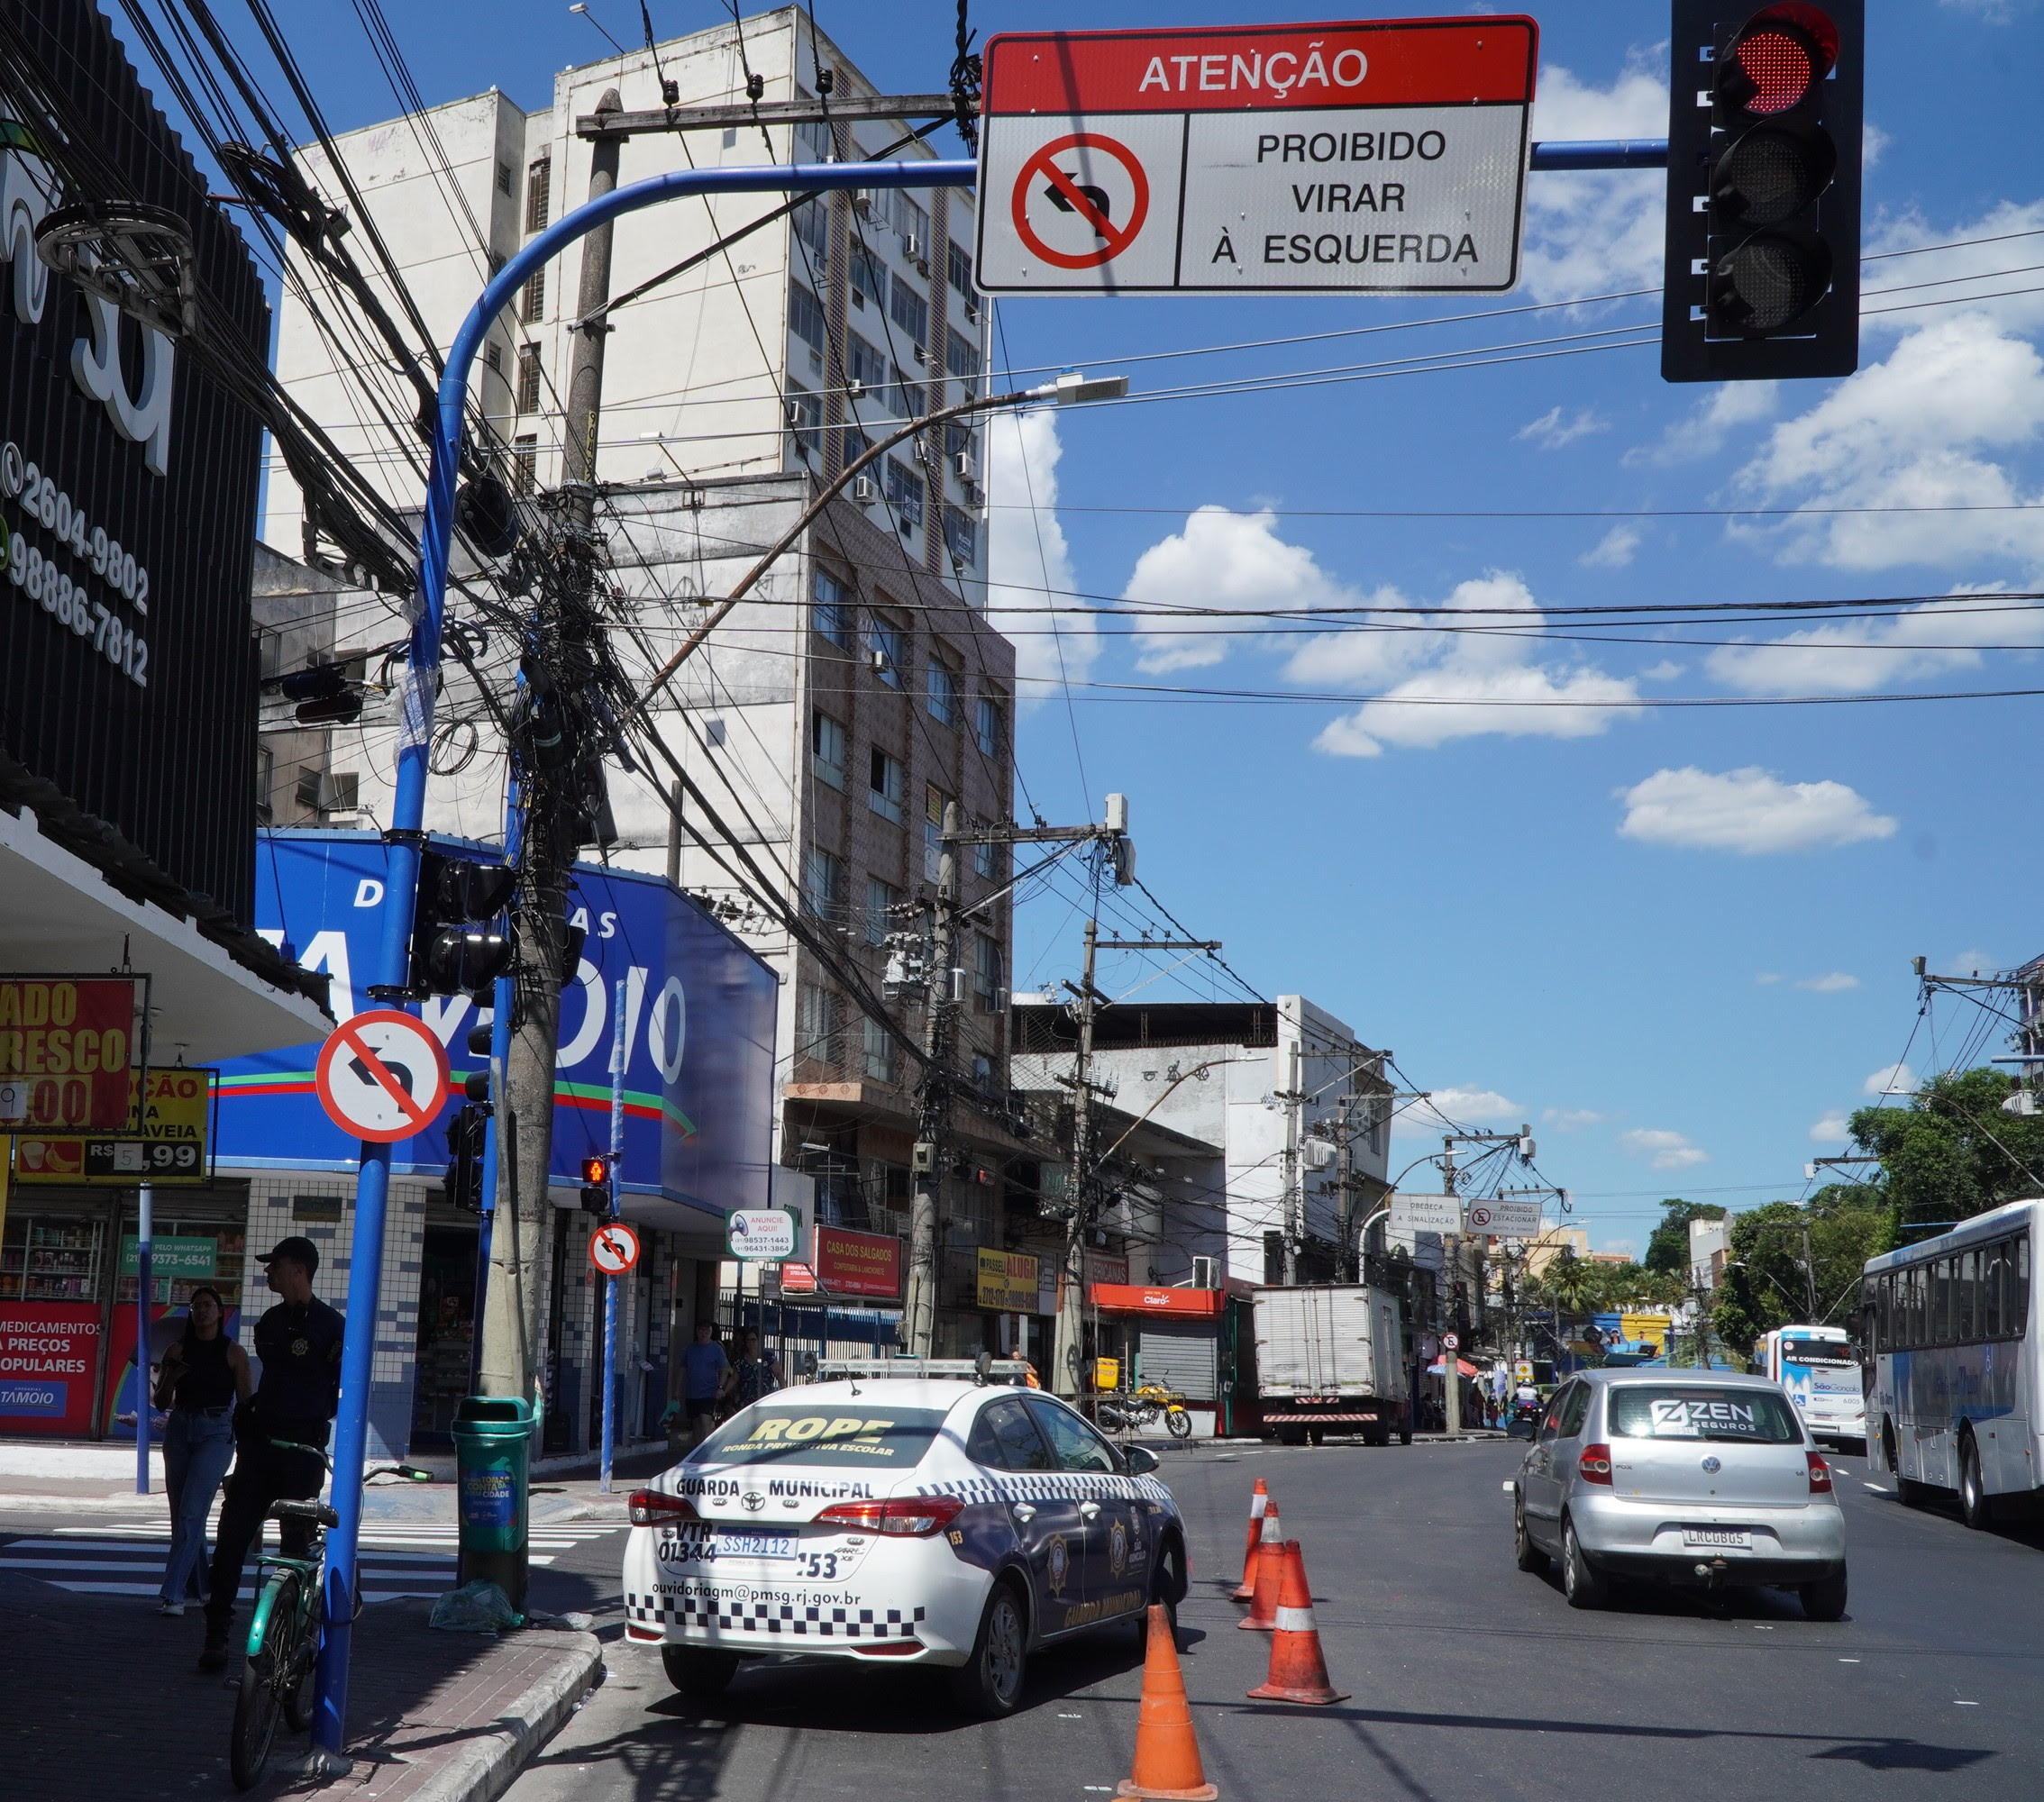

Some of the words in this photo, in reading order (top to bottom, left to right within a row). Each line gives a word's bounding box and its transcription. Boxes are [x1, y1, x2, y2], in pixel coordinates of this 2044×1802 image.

[1138, 41, 1368, 99] ATENÇÃO
[1257, 131, 1446, 163] PROIBIDO
[1292, 183, 1405, 213] VIRAR
[1212, 226, 1236, 264] À
[1264, 233, 1479, 264] ESQUERDA
[20, 462, 149, 617] 2604-9802
[8, 532, 148, 688] 98886-7812
[90, 1144, 114, 1157] R$
[1500, 1205, 1532, 1213] PROIBIDO
[1492, 1215, 1537, 1224] ESTACIONAR
[826, 1241, 844, 1256] CASA
[845, 1244, 858, 1258] DOS
[860, 1246, 892, 1261] SALGADOS
[1007, 1256, 1036, 1279] ALUGA
[1144, 1296, 1166, 1305] Claro
[8, 1338, 70, 1355] PREÇOS
[1799, 1356, 1858, 1365] CONDICIONADO
[0, 1391, 54, 1405] TAMOIO
[1690, 1401, 1755, 1422] ZEN
[748, 1417, 895, 1443] ROPE
[1692, 1421, 1756, 1432] SEGUROS
[722, 1443, 763, 1452] RONDA
[764, 1442, 838, 1452] PREVENTIVA
[840, 1443, 895, 1457] ESCOLAR
[482, 1490, 510, 1498] CIDADE
[676, 1478, 740, 1497] GUARDA
[769, 1479, 873, 1498] MUNICIPAL
[676, 1522, 713, 1543] VTR
[949, 1530, 964, 1545] 153
[652, 1581, 861, 1606] ouvidoriagm@pmsg.rj.gov.br
